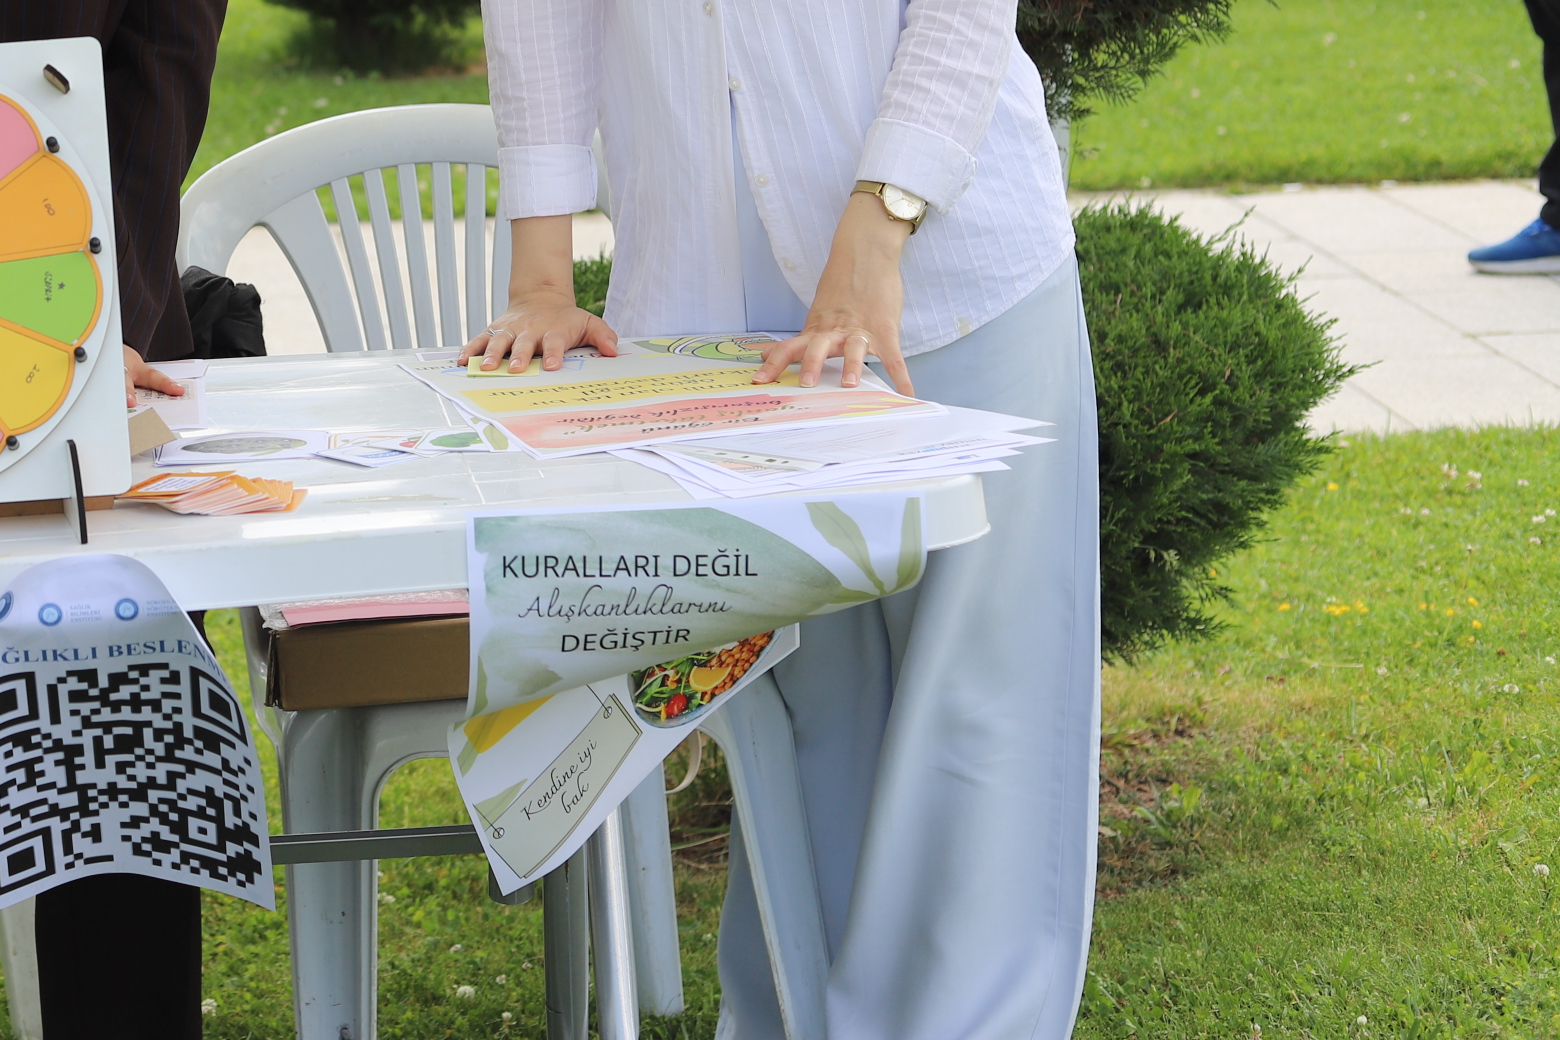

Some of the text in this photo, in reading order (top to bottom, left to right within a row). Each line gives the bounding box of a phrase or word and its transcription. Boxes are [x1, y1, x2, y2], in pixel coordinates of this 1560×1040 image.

[42, 197, 56, 217] 100
[24, 363, 40, 384] 200
[571, 395, 612, 403] tek
[581, 384, 642, 395] değil
[620, 388, 674, 397] olan
[526, 399, 569, 408] bir
[720, 416, 763, 425] Bir
[501, 548, 759, 579] KURALLARI DEĞİL
[517, 583, 733, 624] Alışkanlıklarını
[561, 625, 691, 654] DEĞİŞTİR
[520, 739, 598, 821] Kendine iyi
[561, 771, 590, 816] bak
